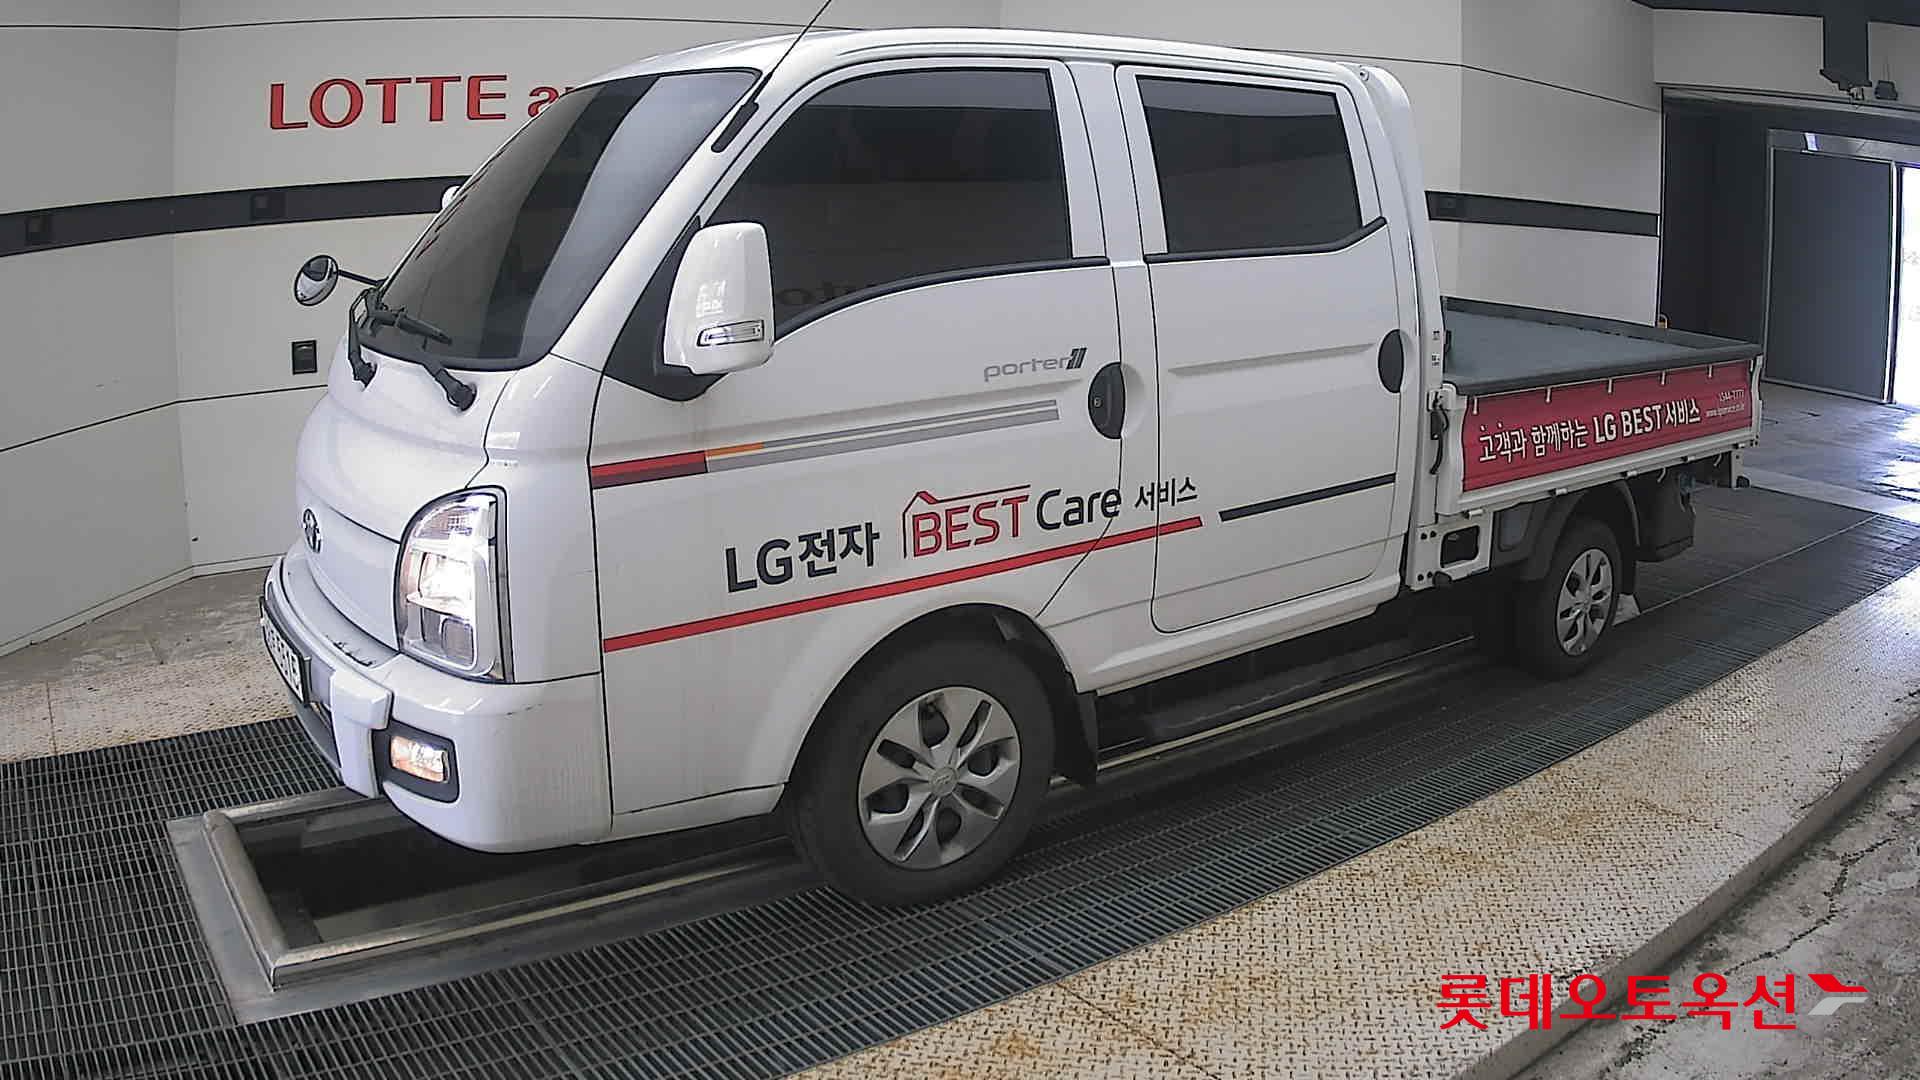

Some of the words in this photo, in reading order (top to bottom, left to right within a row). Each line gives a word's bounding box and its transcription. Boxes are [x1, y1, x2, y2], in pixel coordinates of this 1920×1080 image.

[269, 74, 508, 130] LOTTE
[1479, 423, 1528, 464] 고객과
[1531, 419, 1589, 457] 함께하는
[1593, 413, 1617, 444] LG
[1620, 404, 1663, 437] BEST
[1665, 398, 1702, 428] 서비스
[724, 520, 881, 594] LG전자
[911, 493, 1029, 558] BEST
[1036, 487, 1121, 530] Care
[1134, 475, 1198, 512] 서비스
